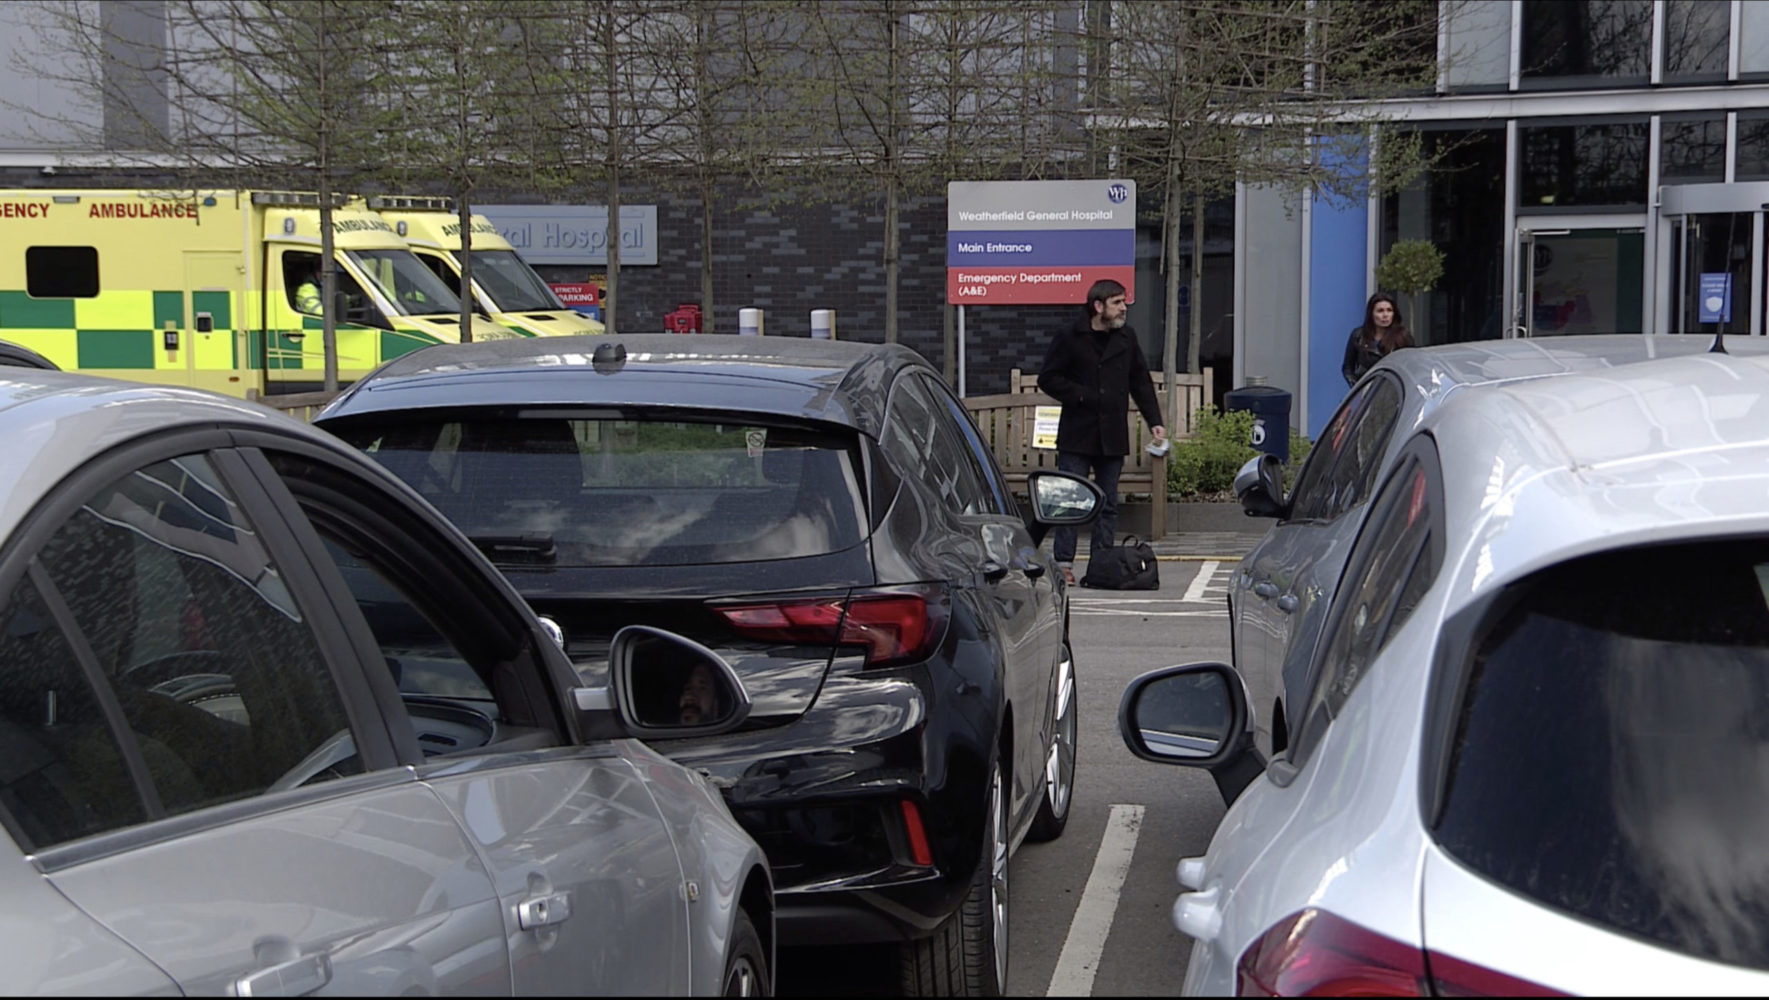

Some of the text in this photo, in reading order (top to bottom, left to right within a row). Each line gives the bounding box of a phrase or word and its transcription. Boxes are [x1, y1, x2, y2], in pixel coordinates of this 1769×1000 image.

[0, 203, 198, 218] ENCY AMBULANCE
[958, 209, 1113, 222] Weatherfield General Hospital
[545, 223, 643, 254] Hospal
[958, 243, 1032, 252] Main Entrance
[958, 273, 1082, 285] Emergency Department
[958, 286, 987, 296] (A&E)
